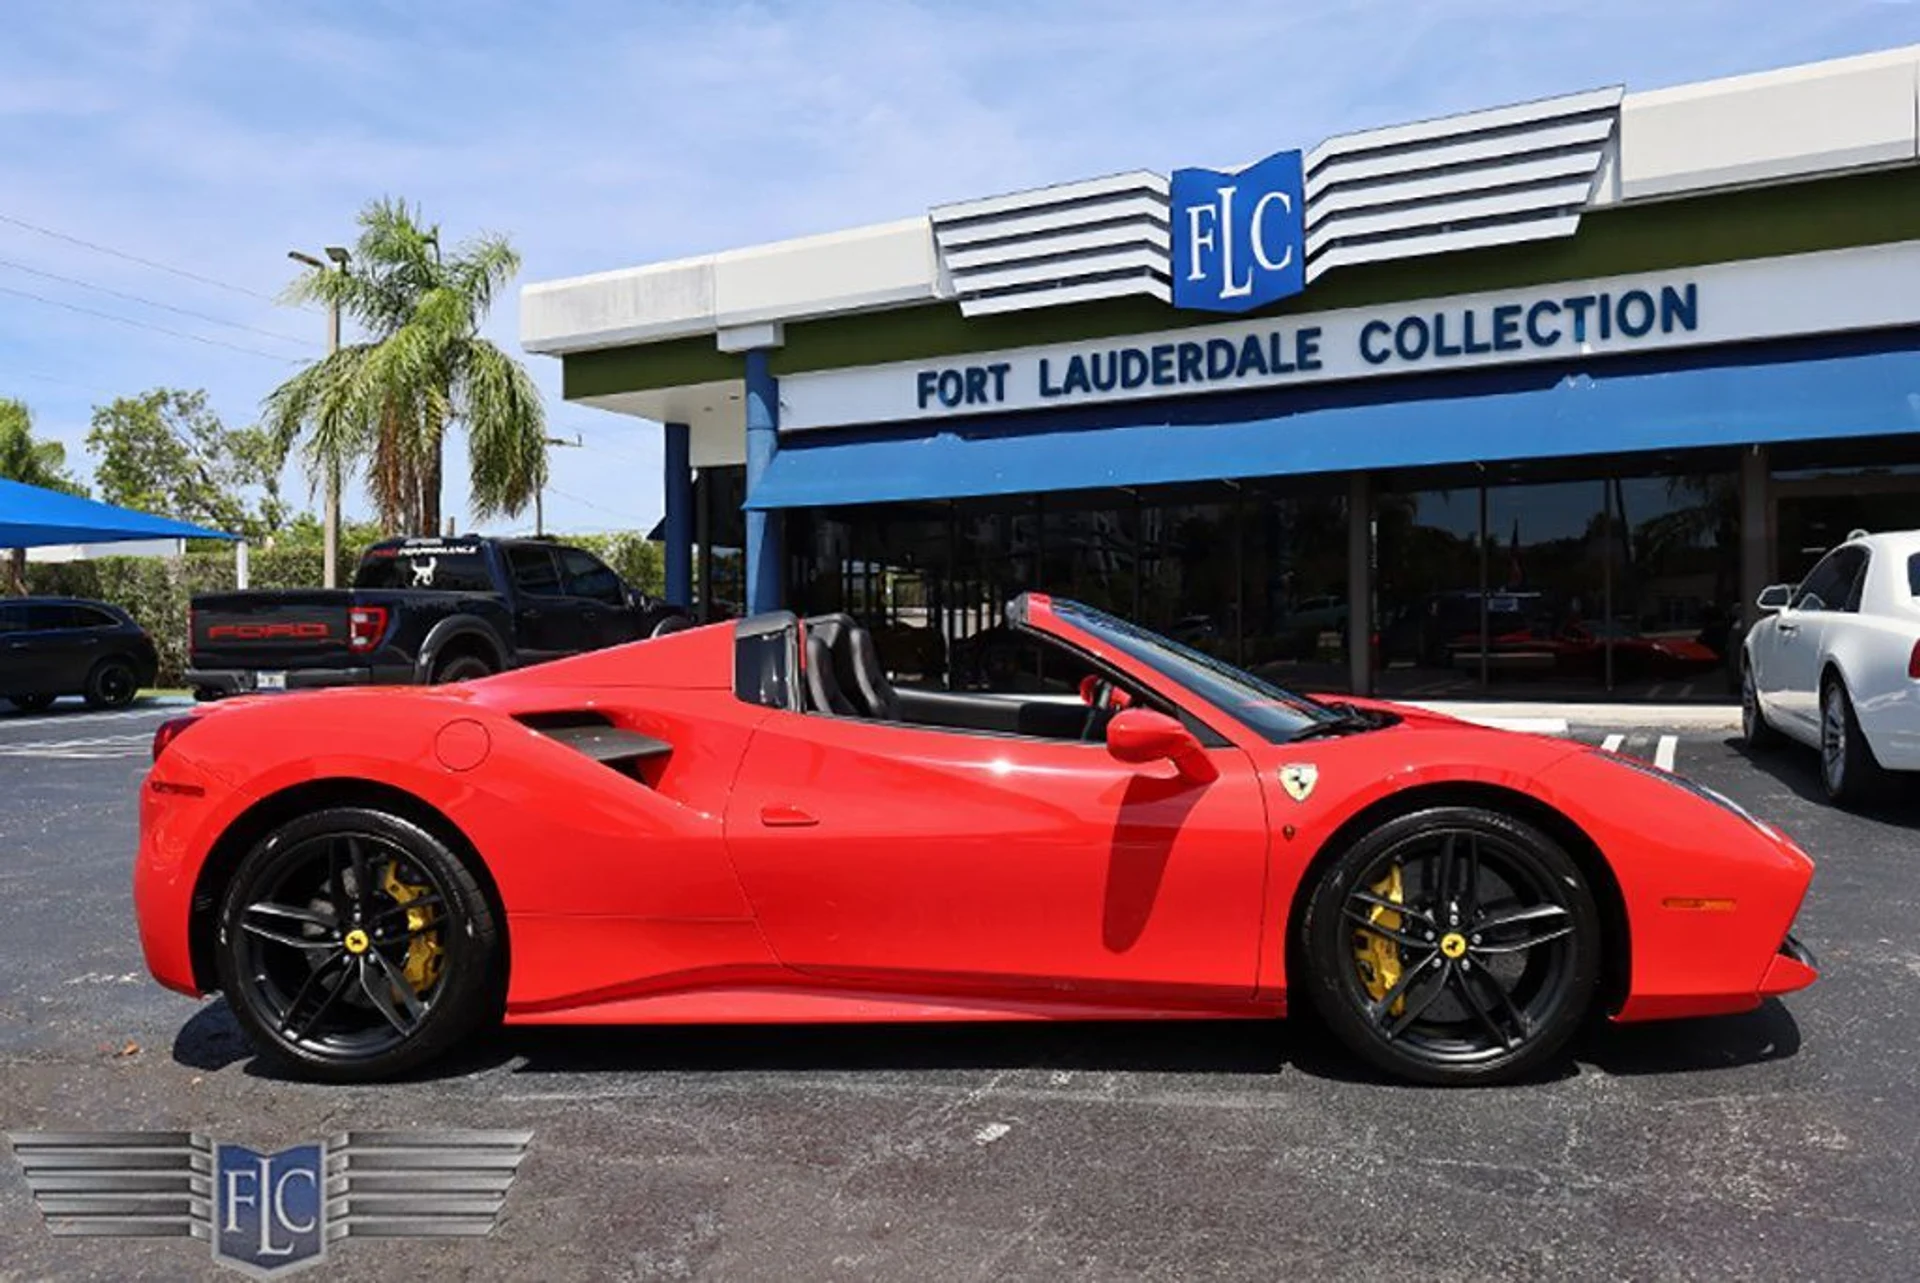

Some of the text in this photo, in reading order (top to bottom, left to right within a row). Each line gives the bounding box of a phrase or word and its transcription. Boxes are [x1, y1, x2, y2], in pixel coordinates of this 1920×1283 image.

[1186, 185, 1292, 300] FLC
[917, 282, 1698, 409] FORT LAUDERDALE COLLECTION
[208, 622, 329, 639] FORD
